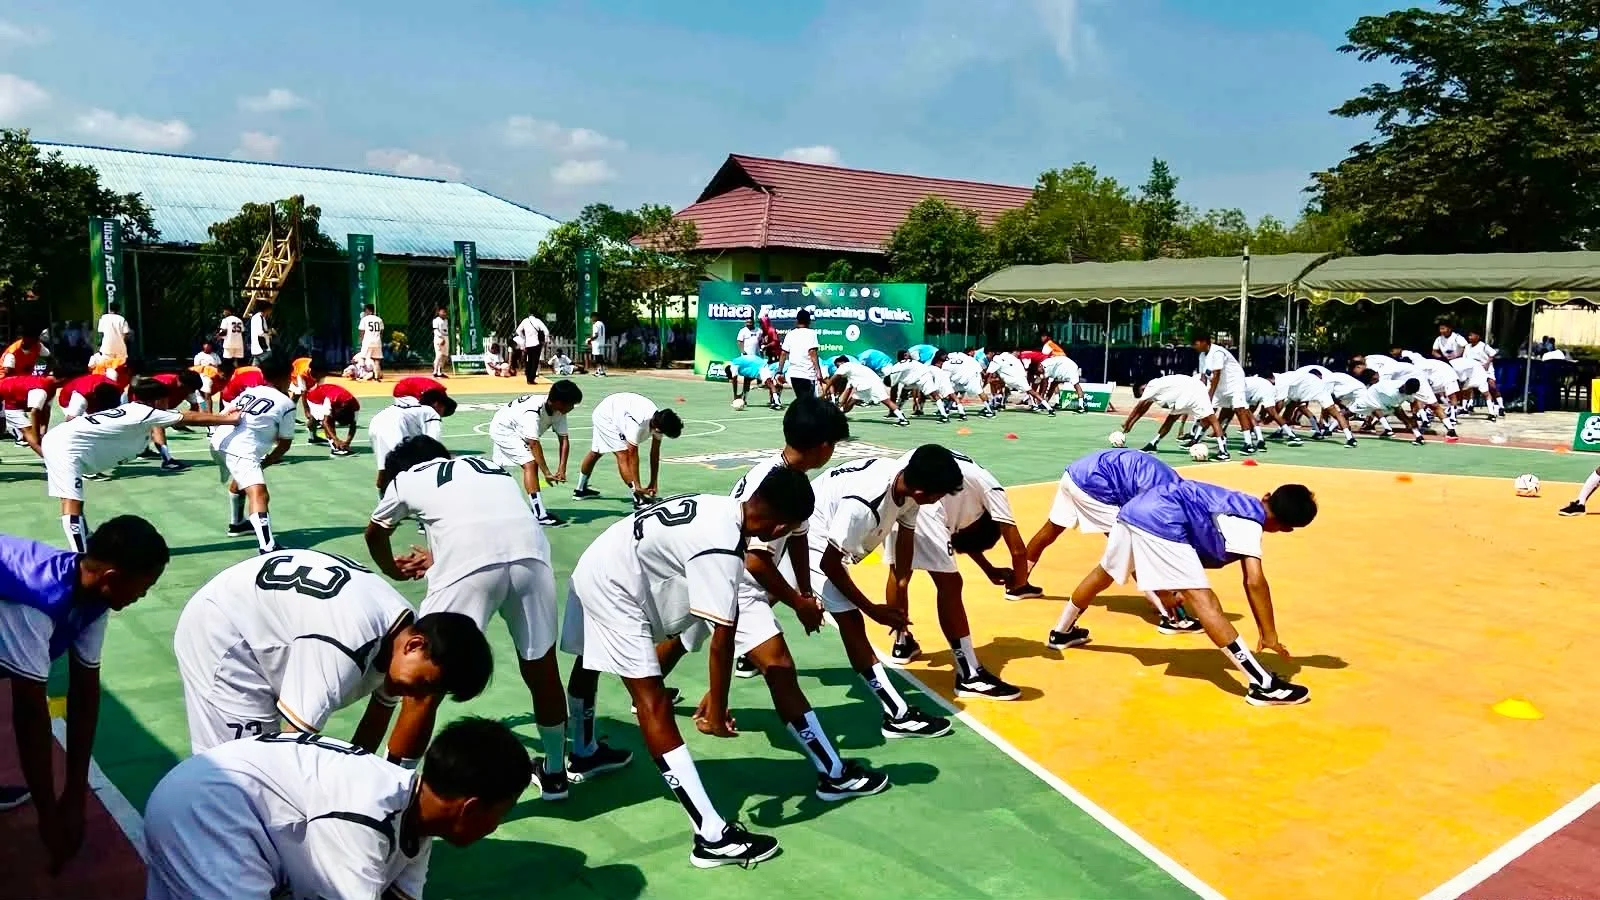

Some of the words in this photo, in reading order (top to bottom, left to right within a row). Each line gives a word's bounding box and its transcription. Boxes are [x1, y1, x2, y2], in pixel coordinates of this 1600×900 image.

[103, 221, 114, 250] Ithaca
[105, 254, 115, 282] Futsal
[708, 303, 752, 319] Ithaca
[804, 305, 866, 321] Coaching
[868, 306, 912, 324] Clinic
